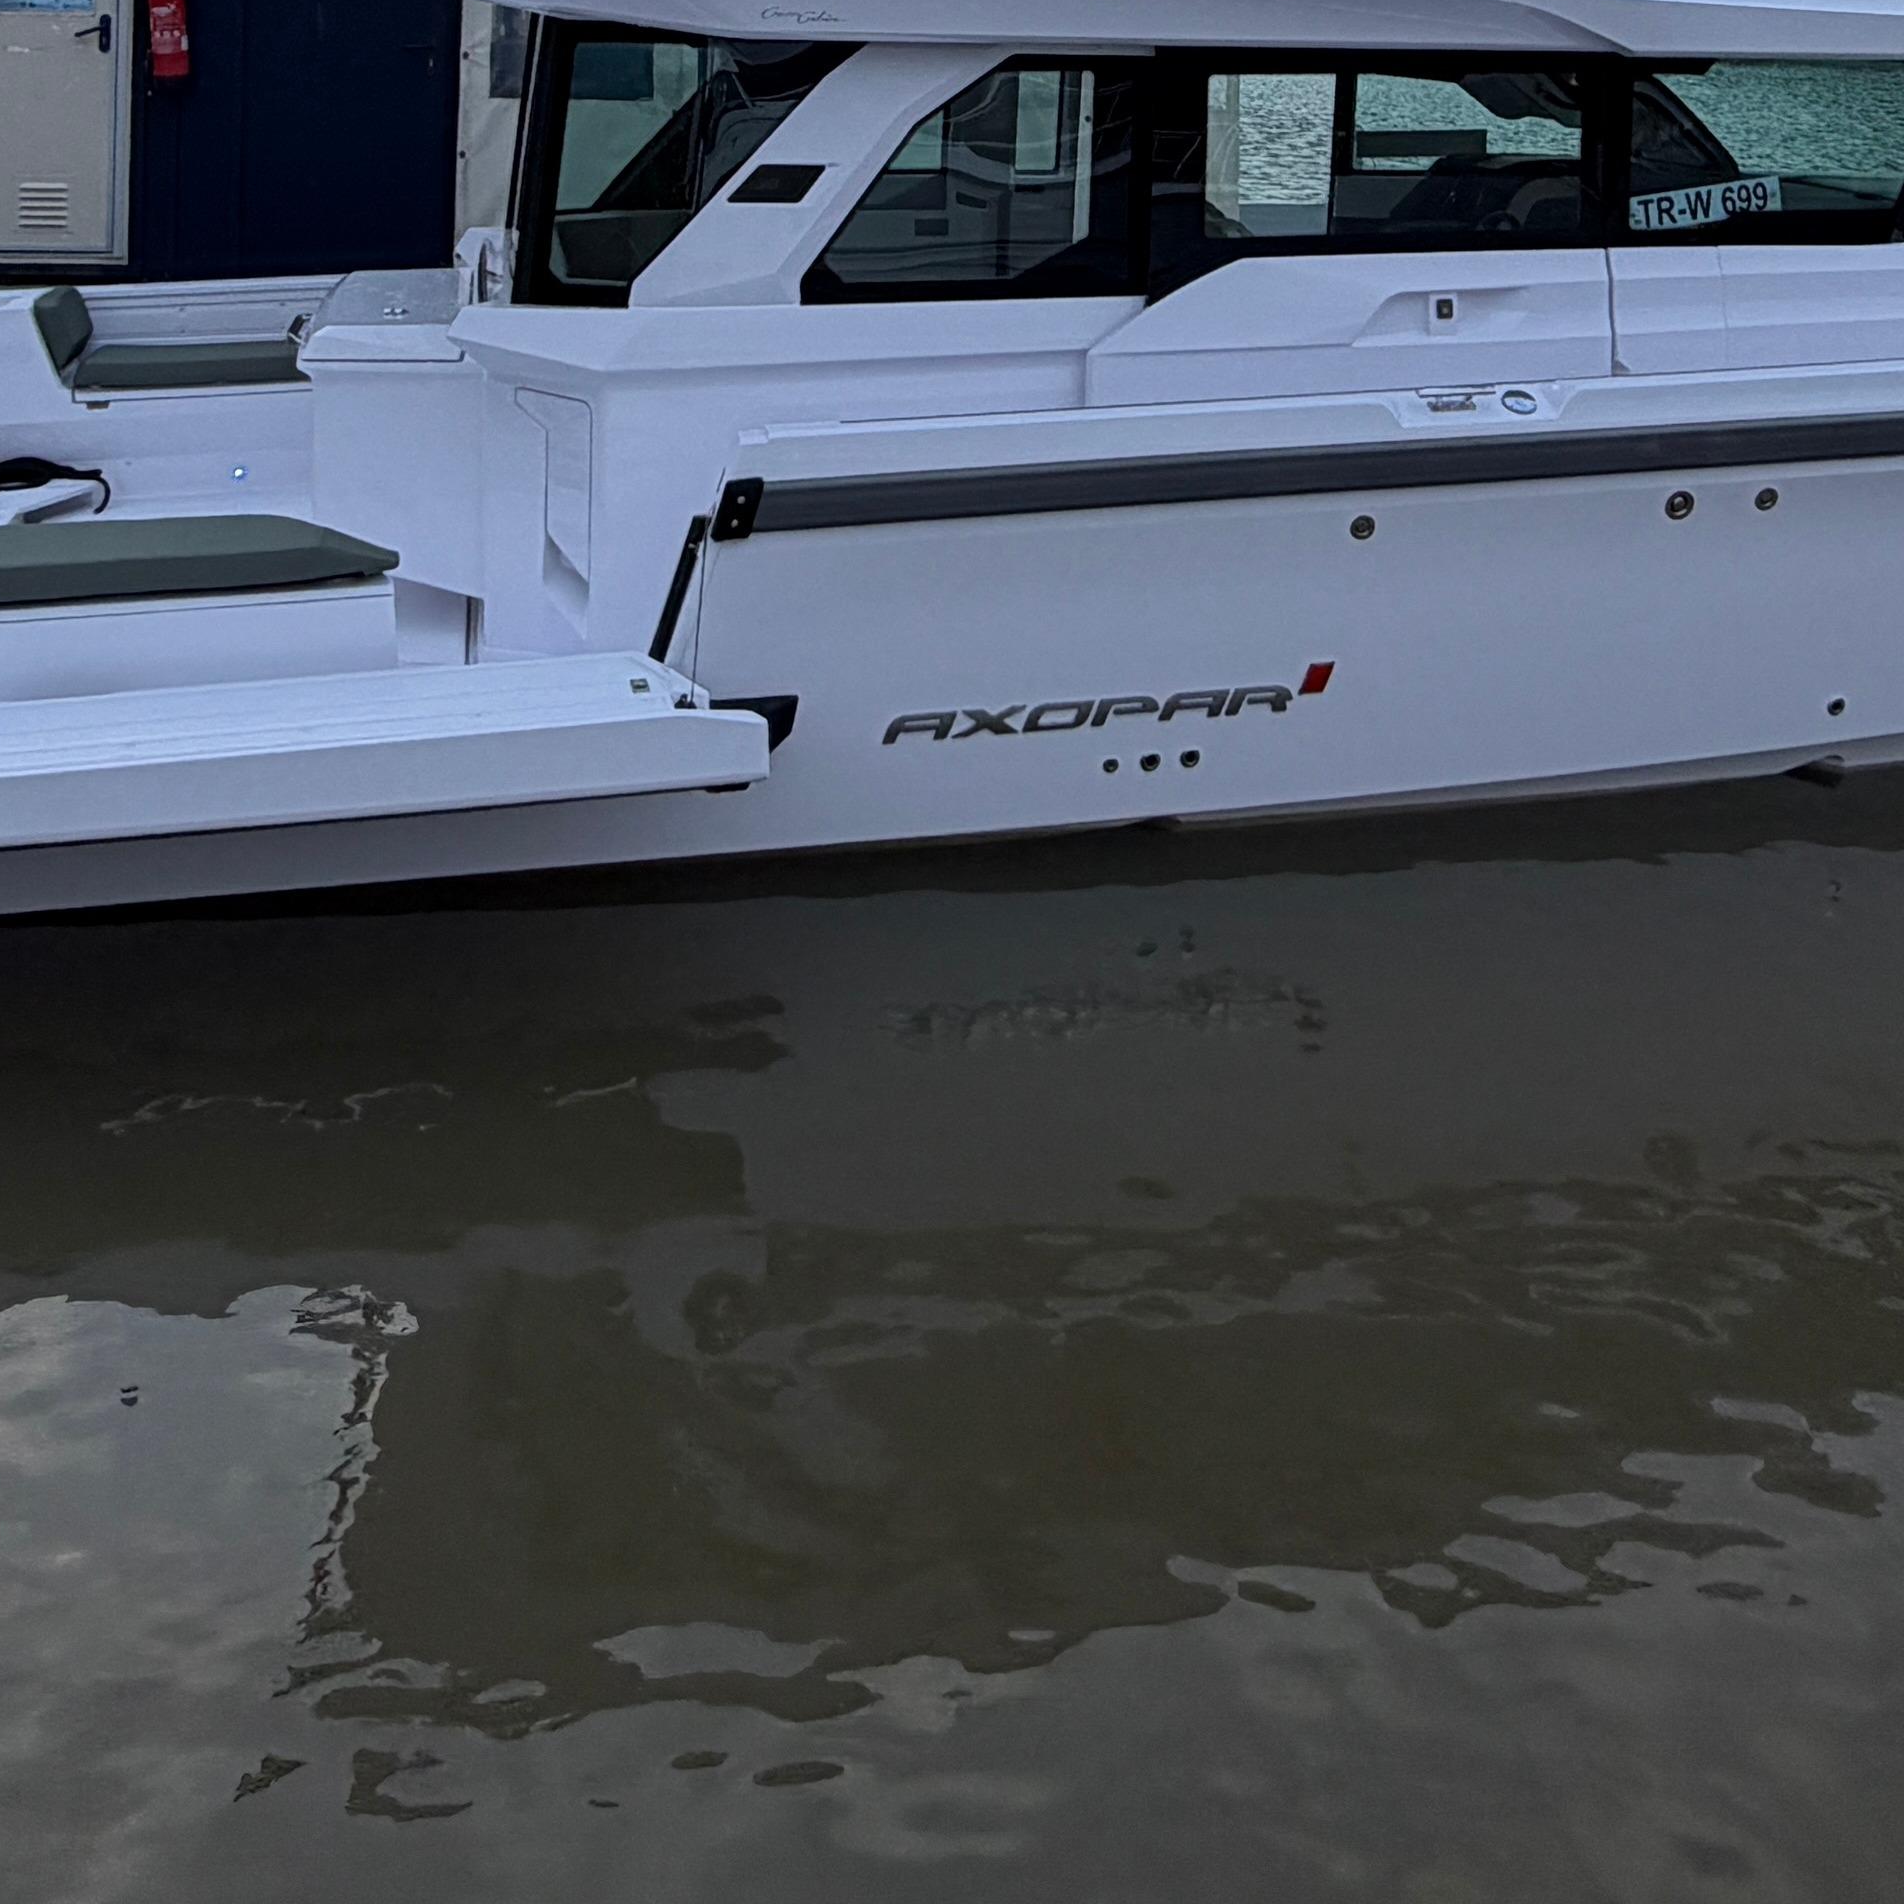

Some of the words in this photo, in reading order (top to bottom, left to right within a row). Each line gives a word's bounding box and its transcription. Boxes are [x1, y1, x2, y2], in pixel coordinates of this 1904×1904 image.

[1637, 187, 1712, 229] TR-W
[1721, 182, 1769, 217] 699
[881, 684, 1295, 745] AXOPAR
